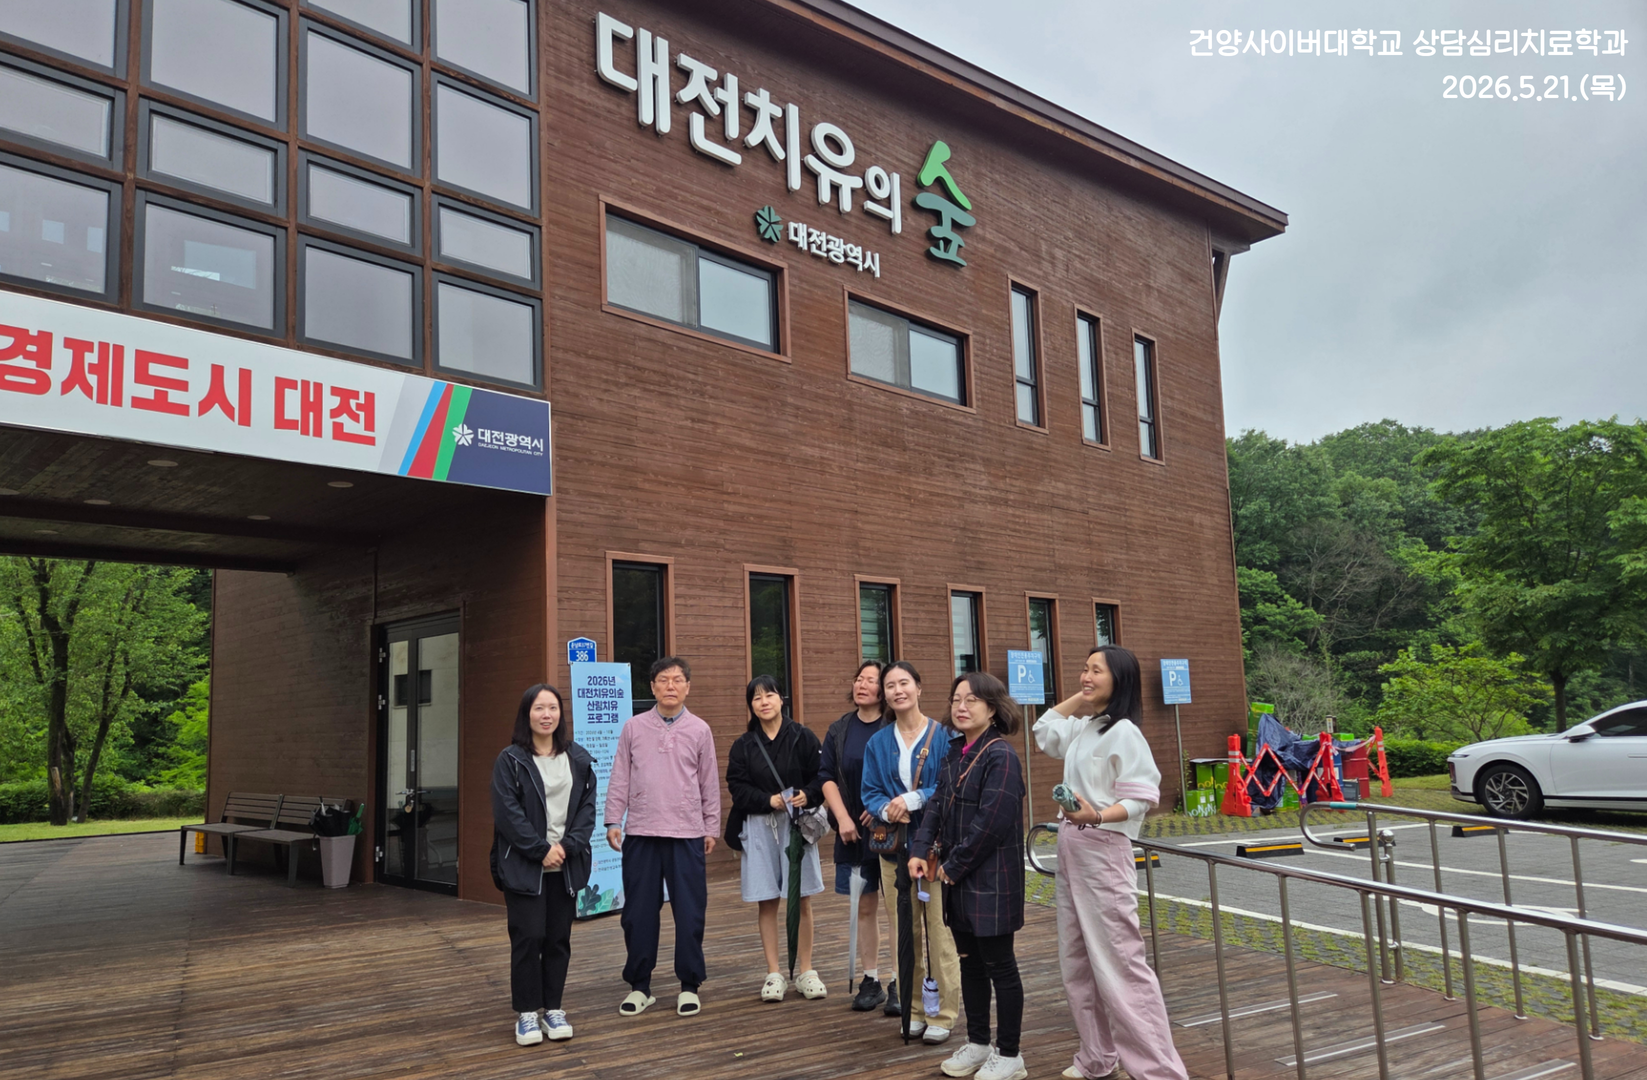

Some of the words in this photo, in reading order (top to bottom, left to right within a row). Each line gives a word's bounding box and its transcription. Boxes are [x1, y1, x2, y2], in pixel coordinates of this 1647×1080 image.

[914, 139, 977, 267] 숲
[787, 221, 881, 278] 대전광역시
[0, 324, 252, 427] 경제도시
[274, 376, 376, 446] 대전
[478, 428, 543, 452] 대전광역시
[500, 446, 532, 455] METROPOLITAN
[575, 650, 589, 662] 386
[587, 675, 616, 687] 2026년
[1018, 665, 1027, 683] P
[1169, 671, 1177, 687] P
[577, 688, 625, 699] 대전치유의숲
[587, 700, 619, 712] 산림치유
[587, 713, 619, 724] 프로그램
